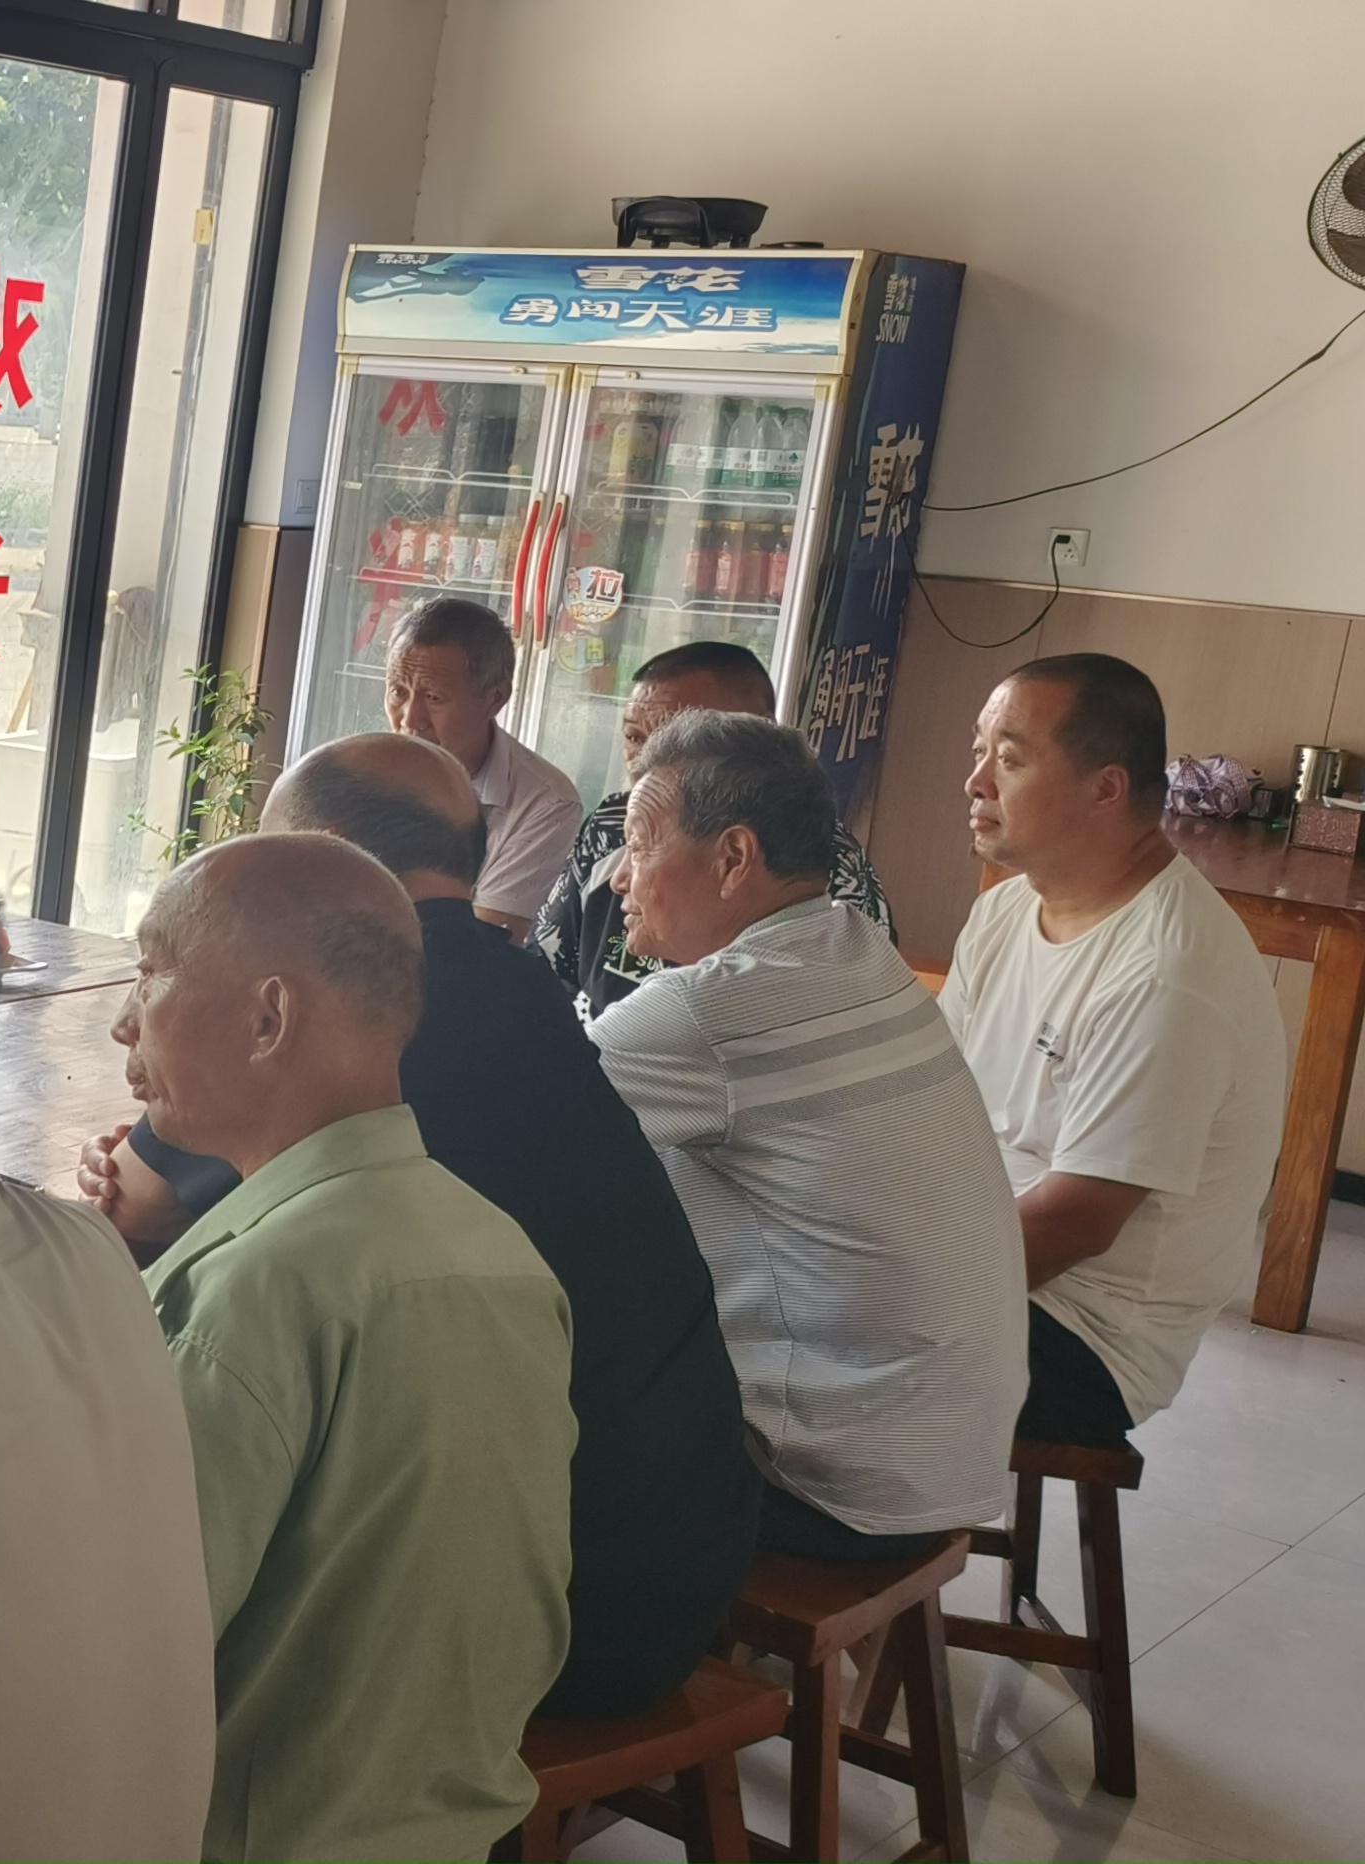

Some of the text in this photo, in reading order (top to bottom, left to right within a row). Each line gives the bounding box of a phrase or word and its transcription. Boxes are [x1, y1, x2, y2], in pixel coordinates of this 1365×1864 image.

[576, 265, 746, 292] 雪花
[505, 299, 773, 329] 勇闯天涯
[875, 313, 910, 344] SNOW
[586, 569, 622, 602] 拉
[808, 643, 889, 764] 勇闯天涯
